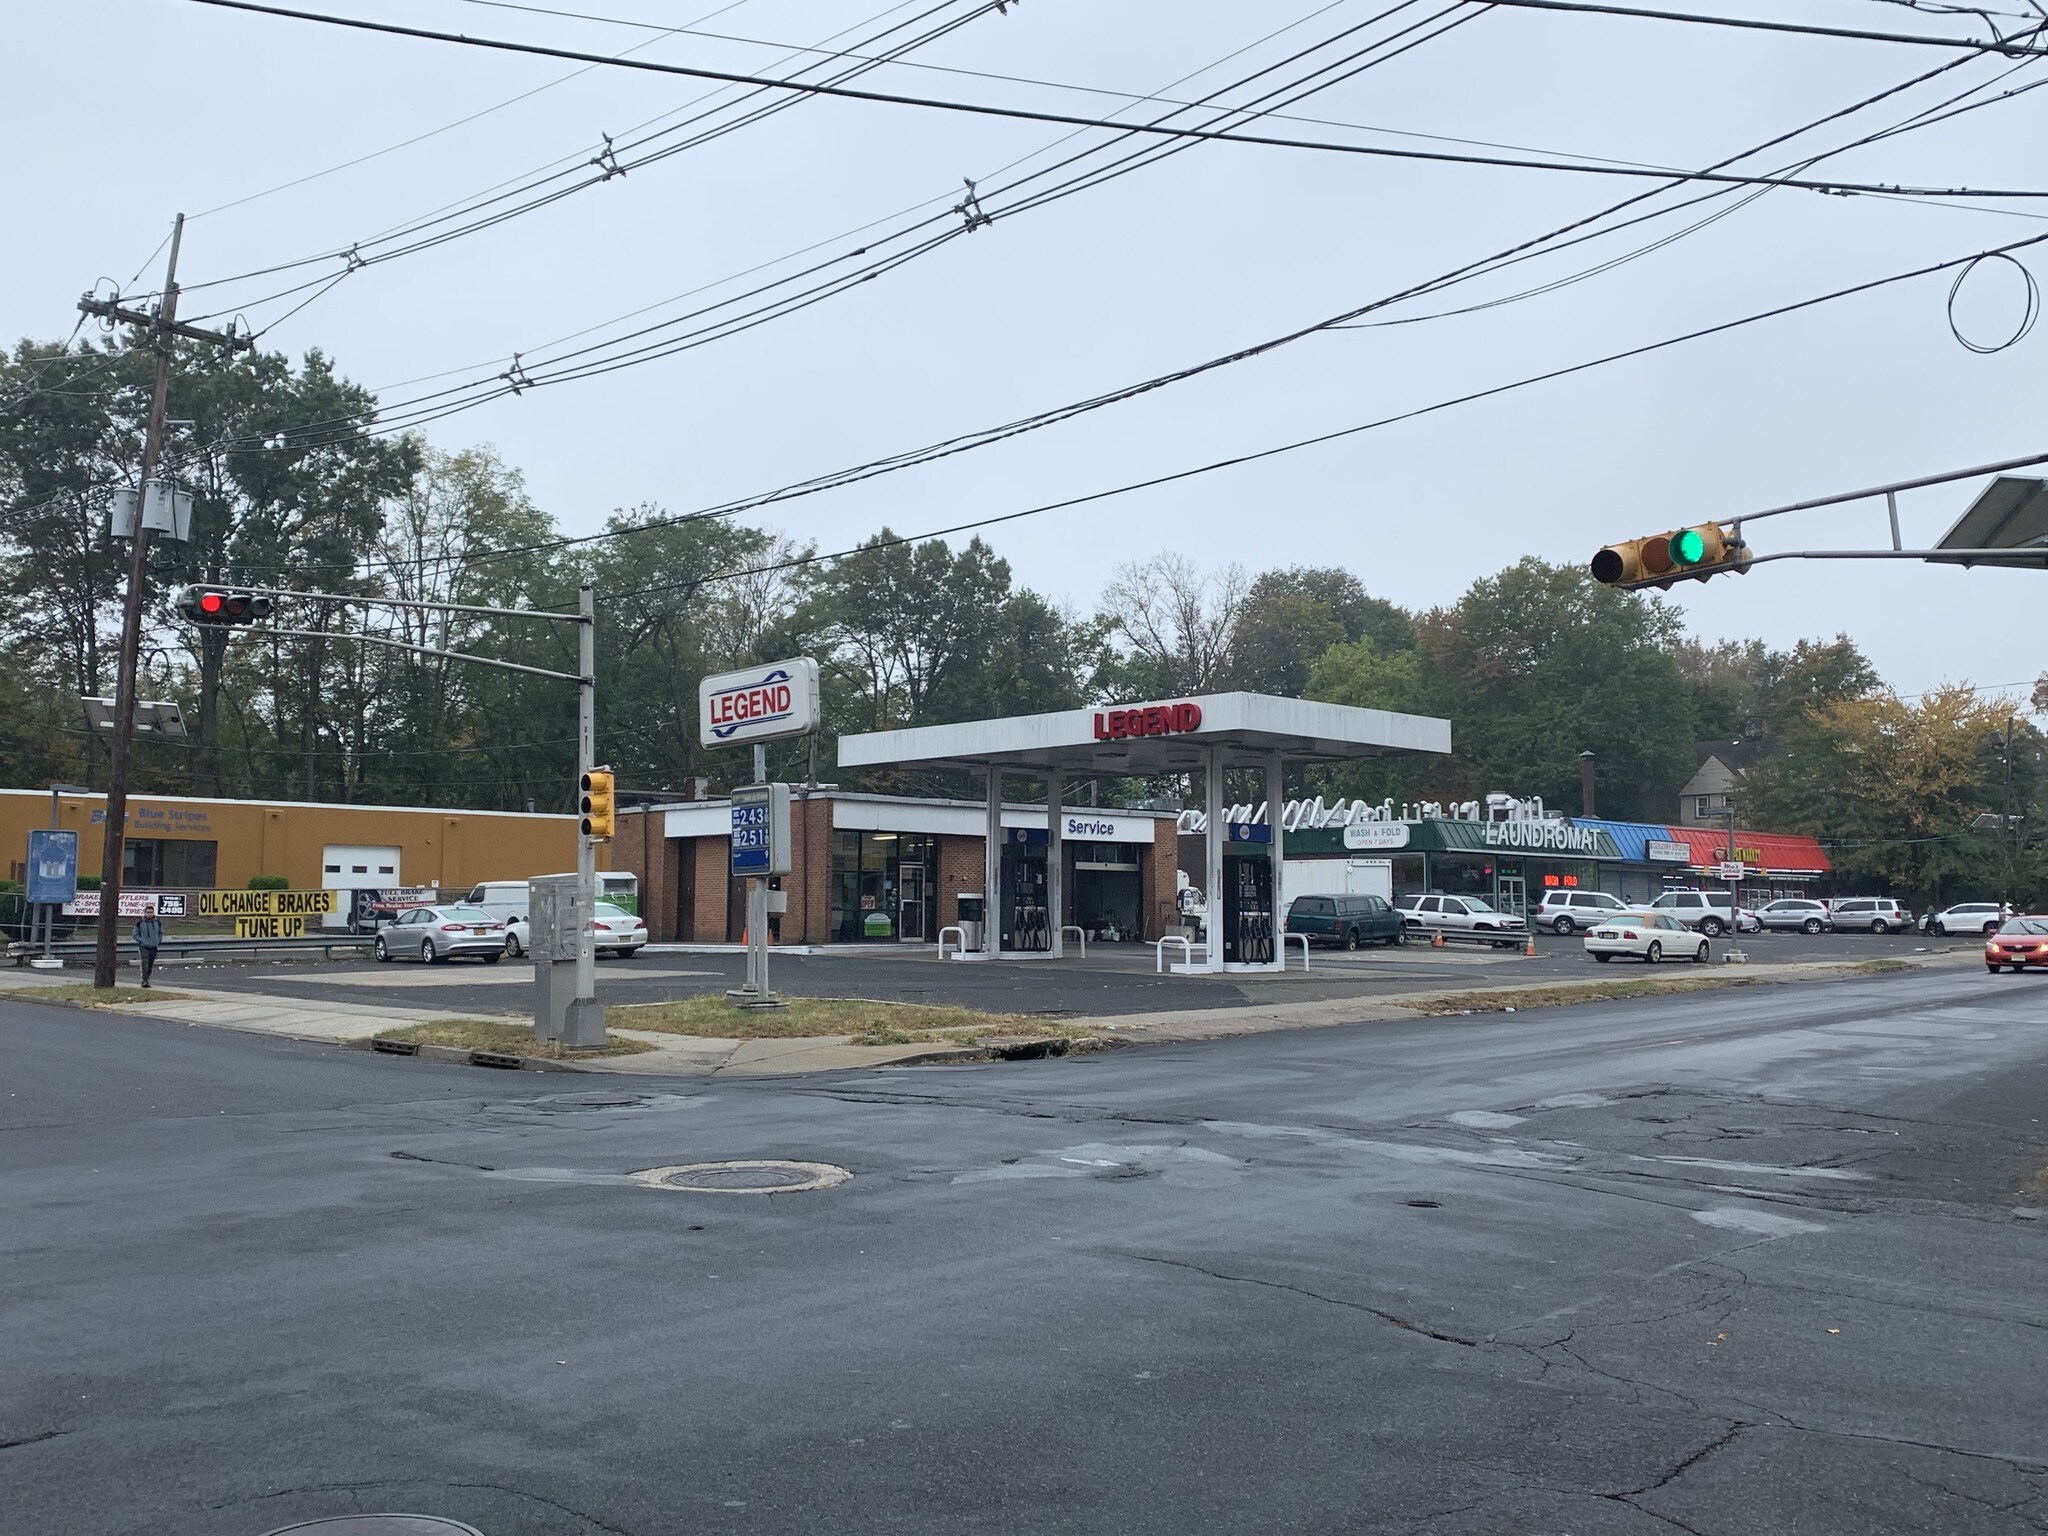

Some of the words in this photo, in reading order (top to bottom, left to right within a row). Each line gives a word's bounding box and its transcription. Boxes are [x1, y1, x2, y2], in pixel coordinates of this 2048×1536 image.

[710, 685, 791, 724] LEGEND
[1094, 703, 1202, 740] LEGEND
[138, 807, 164, 818] Blue
[168, 809, 208, 821] Stripes
[740, 808, 764, 825] 2.43
[134, 820, 172, 832] Building
[1068, 819, 1114, 835] Service
[1350, 829, 1371, 838] WASH
[1382, 828, 1401, 837] FOLD
[1485, 820, 1601, 850] LAUNDROMAT
[740, 829, 763, 846] 2.51
[200, 894, 218, 913] OIL
[222, 893, 269, 913] CHANGE
[278, 893, 330, 913] BRAKES
[239, 918, 279, 938] TUNE
[283, 918, 302, 937] UP
